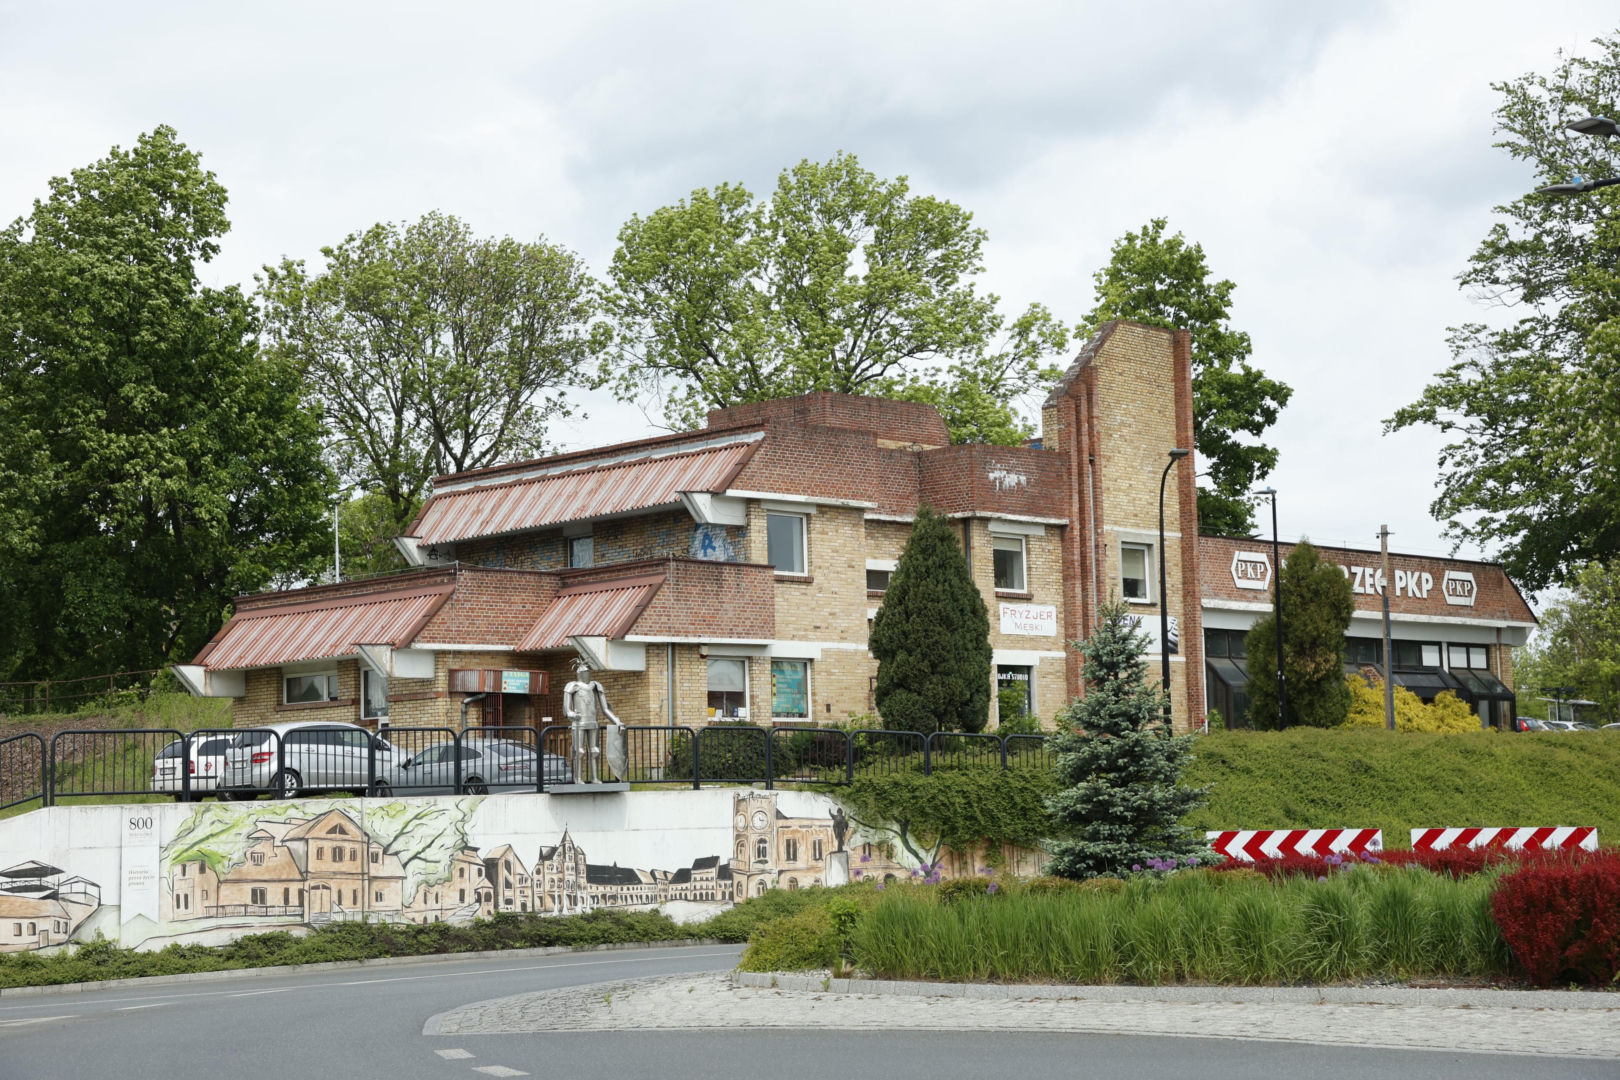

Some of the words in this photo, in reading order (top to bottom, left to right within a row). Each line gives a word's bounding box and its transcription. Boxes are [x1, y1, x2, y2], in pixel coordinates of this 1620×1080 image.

[1237, 561, 1264, 578] PKP
[1394, 569, 1433, 599] PKP
[1448, 580, 1471, 596] PKP
[1002, 607, 1053, 620] FRYZJER
[129, 817, 153, 831] 800
